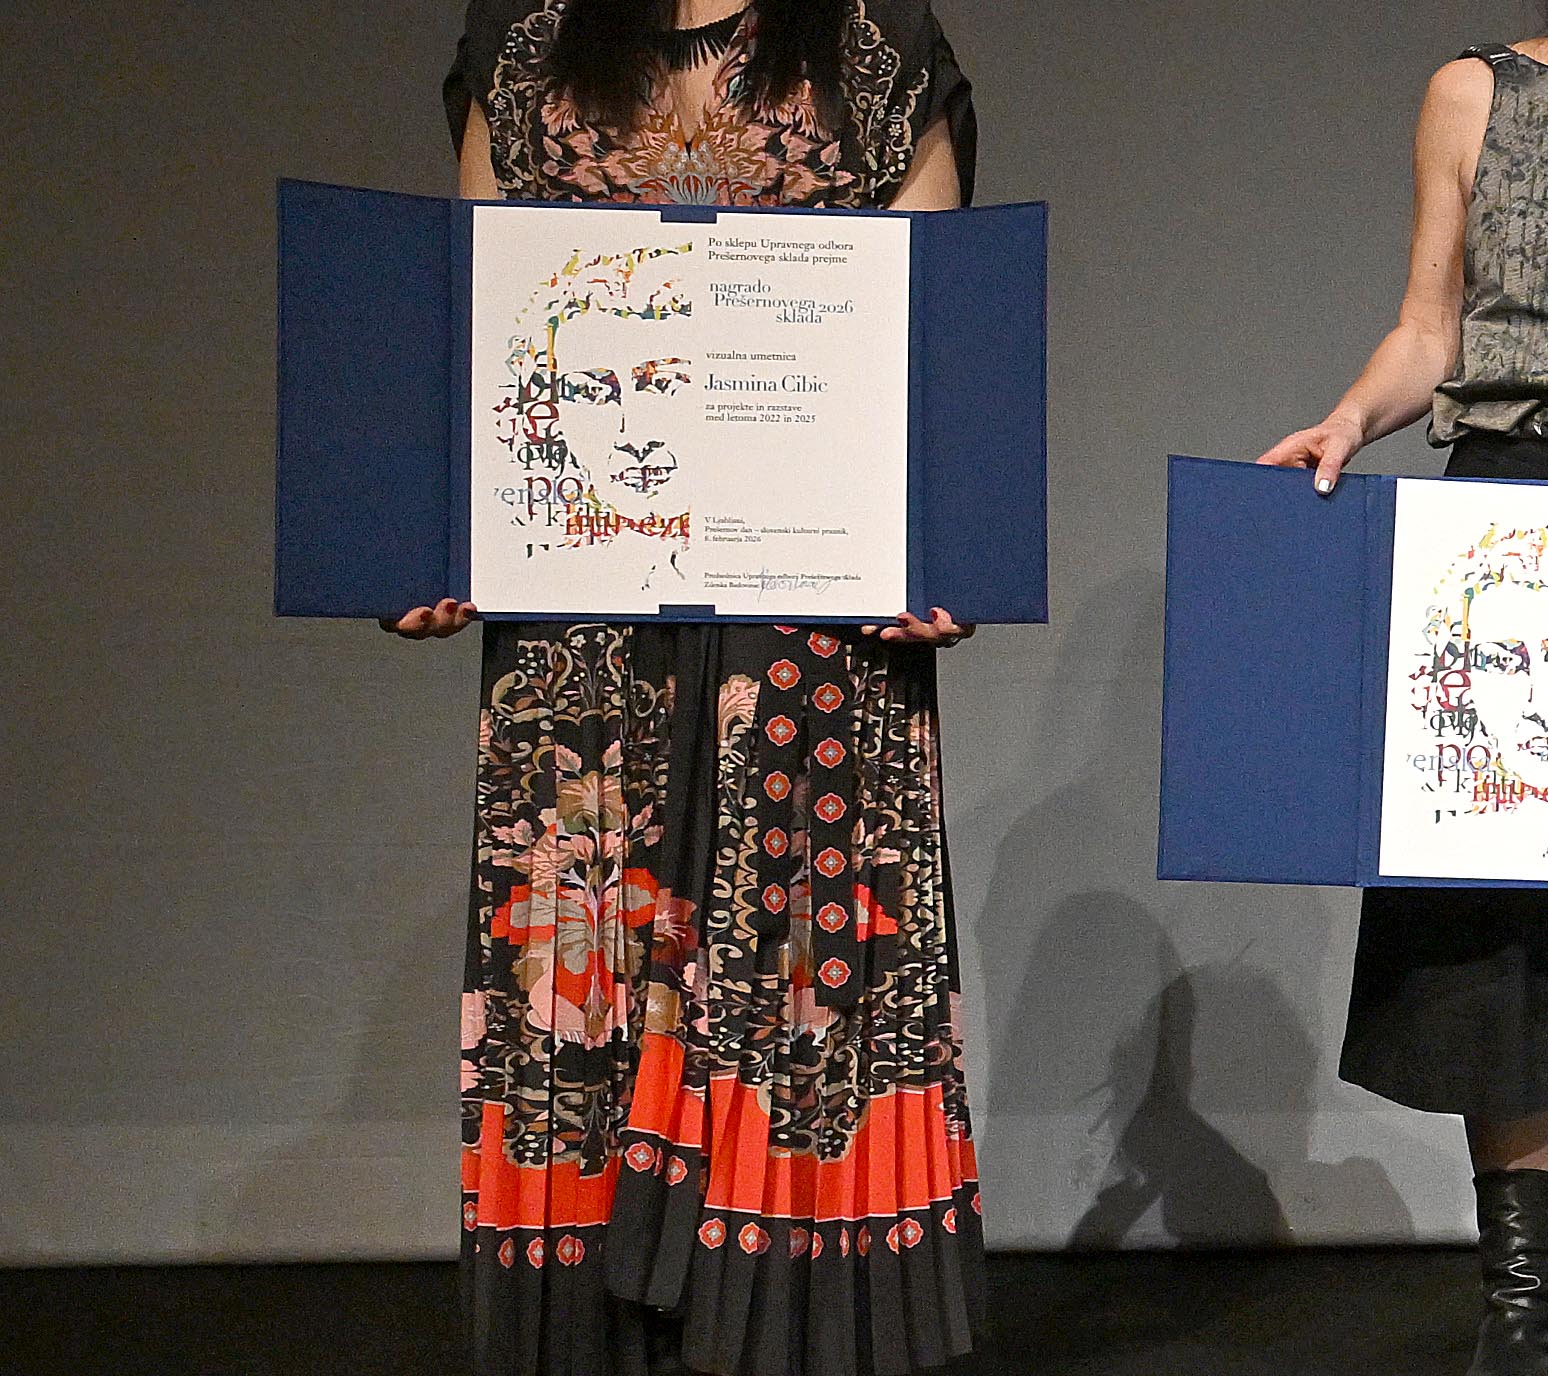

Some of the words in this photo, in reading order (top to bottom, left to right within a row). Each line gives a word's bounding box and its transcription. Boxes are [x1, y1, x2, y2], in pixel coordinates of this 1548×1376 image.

[709, 238, 722, 247] Po
[725, 238, 757, 250] sklepu
[760, 239, 815, 251] Upravnega
[819, 241, 853, 250] odbora
[709, 251, 775, 264] Prešernovega
[779, 253, 809, 262] sklada
[813, 254, 847, 265] prejme
[710, 279, 771, 297] nagrado
[715, 293, 815, 313] Prešernovega
[819, 300, 853, 313] 2026
[776, 309, 821, 323] sklada
[706, 351, 747, 360] vizualna
[751, 352, 796, 361] umetnica
[704, 374, 777, 391] Jasmina
[782, 375, 828, 392] Cibic
[718, 402, 753, 412] projekte
[706, 413, 724, 421] med
[727, 414, 757, 422] letoma
